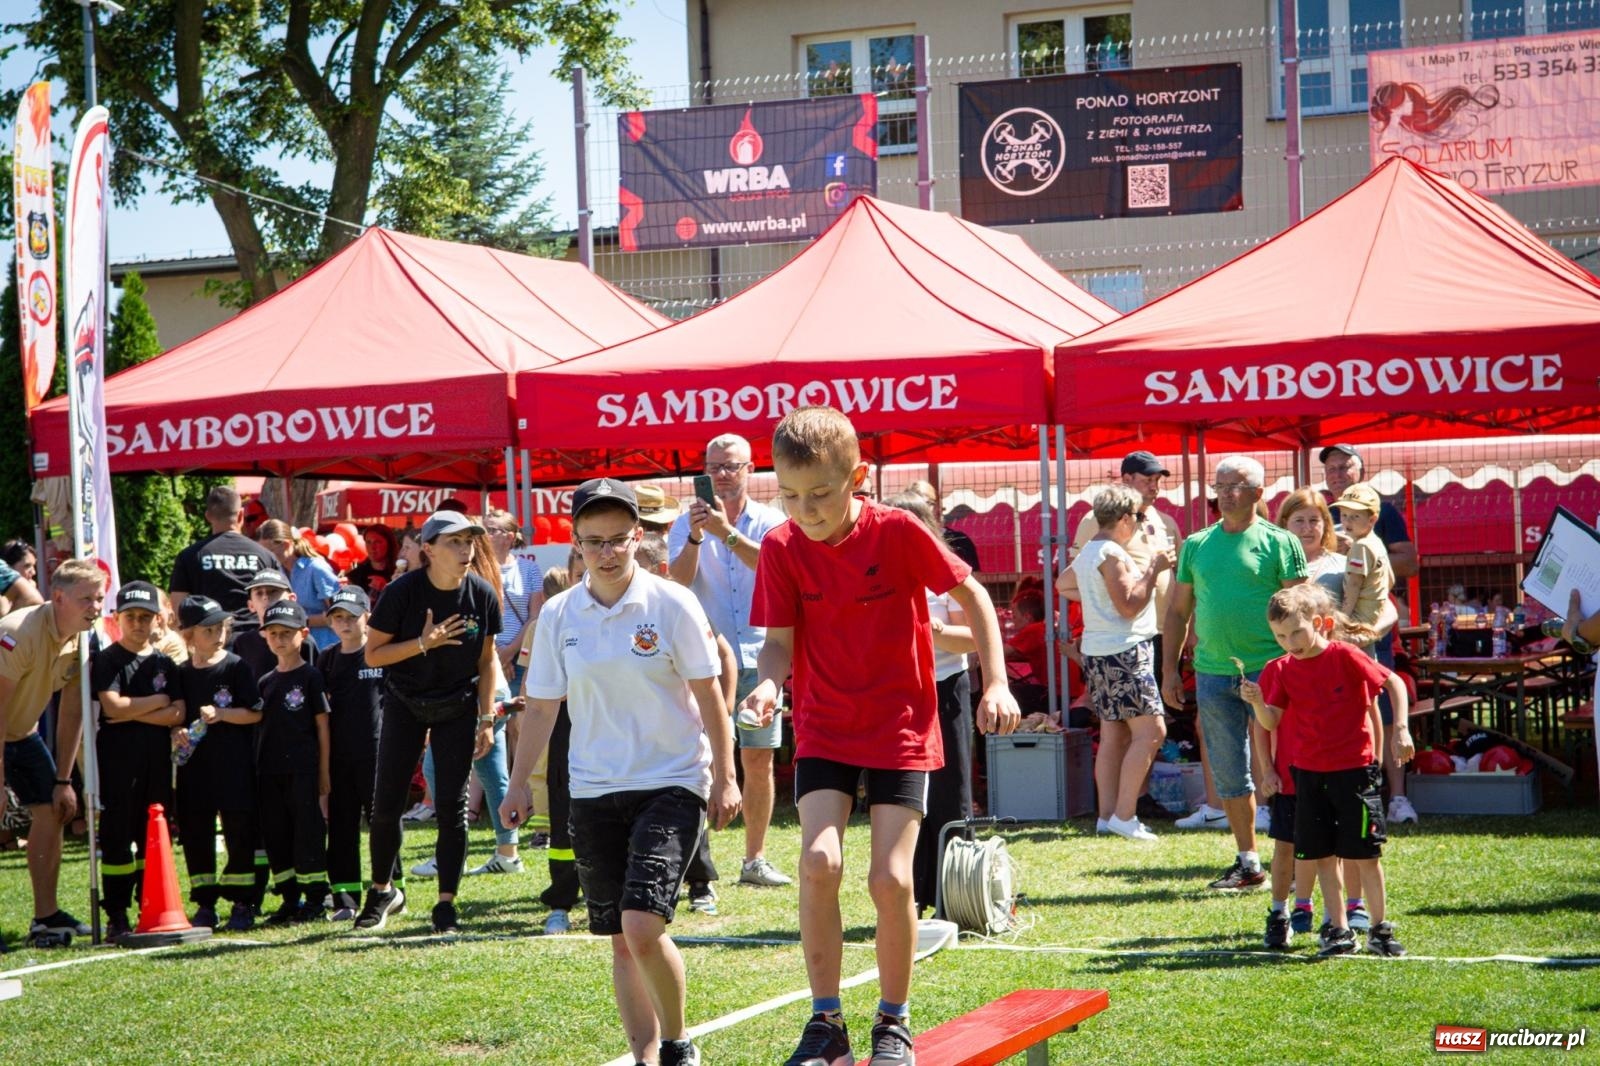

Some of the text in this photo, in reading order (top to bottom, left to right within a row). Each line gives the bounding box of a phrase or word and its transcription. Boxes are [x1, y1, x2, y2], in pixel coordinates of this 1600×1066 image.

[1428, 54, 1455, 68] Maja
[1513, 43, 1576, 57] Pietrowice
[1463, 67, 1489, 85] tel.
[1494, 62, 1531, 82] 533
[1537, 58, 1577, 77] 354
[1075, 88, 1221, 110] PONAD HORYZONT
[1086, 123, 1212, 140] Z ZIEMI & POWIETRZA
[1112, 114, 1184, 126] FOTOGRAFIA
[994, 149, 1053, 161] HORYZONT
[1004, 143, 1042, 153] PONAD
[703, 164, 791, 194] WRBA
[1484, 158, 1579, 189] FRYZUR
[702, 212, 807, 235] www.wrba.pl
[1143, 353, 1564, 406] SAMBOROWICE
[596, 373, 960, 429] SAMBOROWICE
[105, 402, 436, 458] SAMBOROWICE
